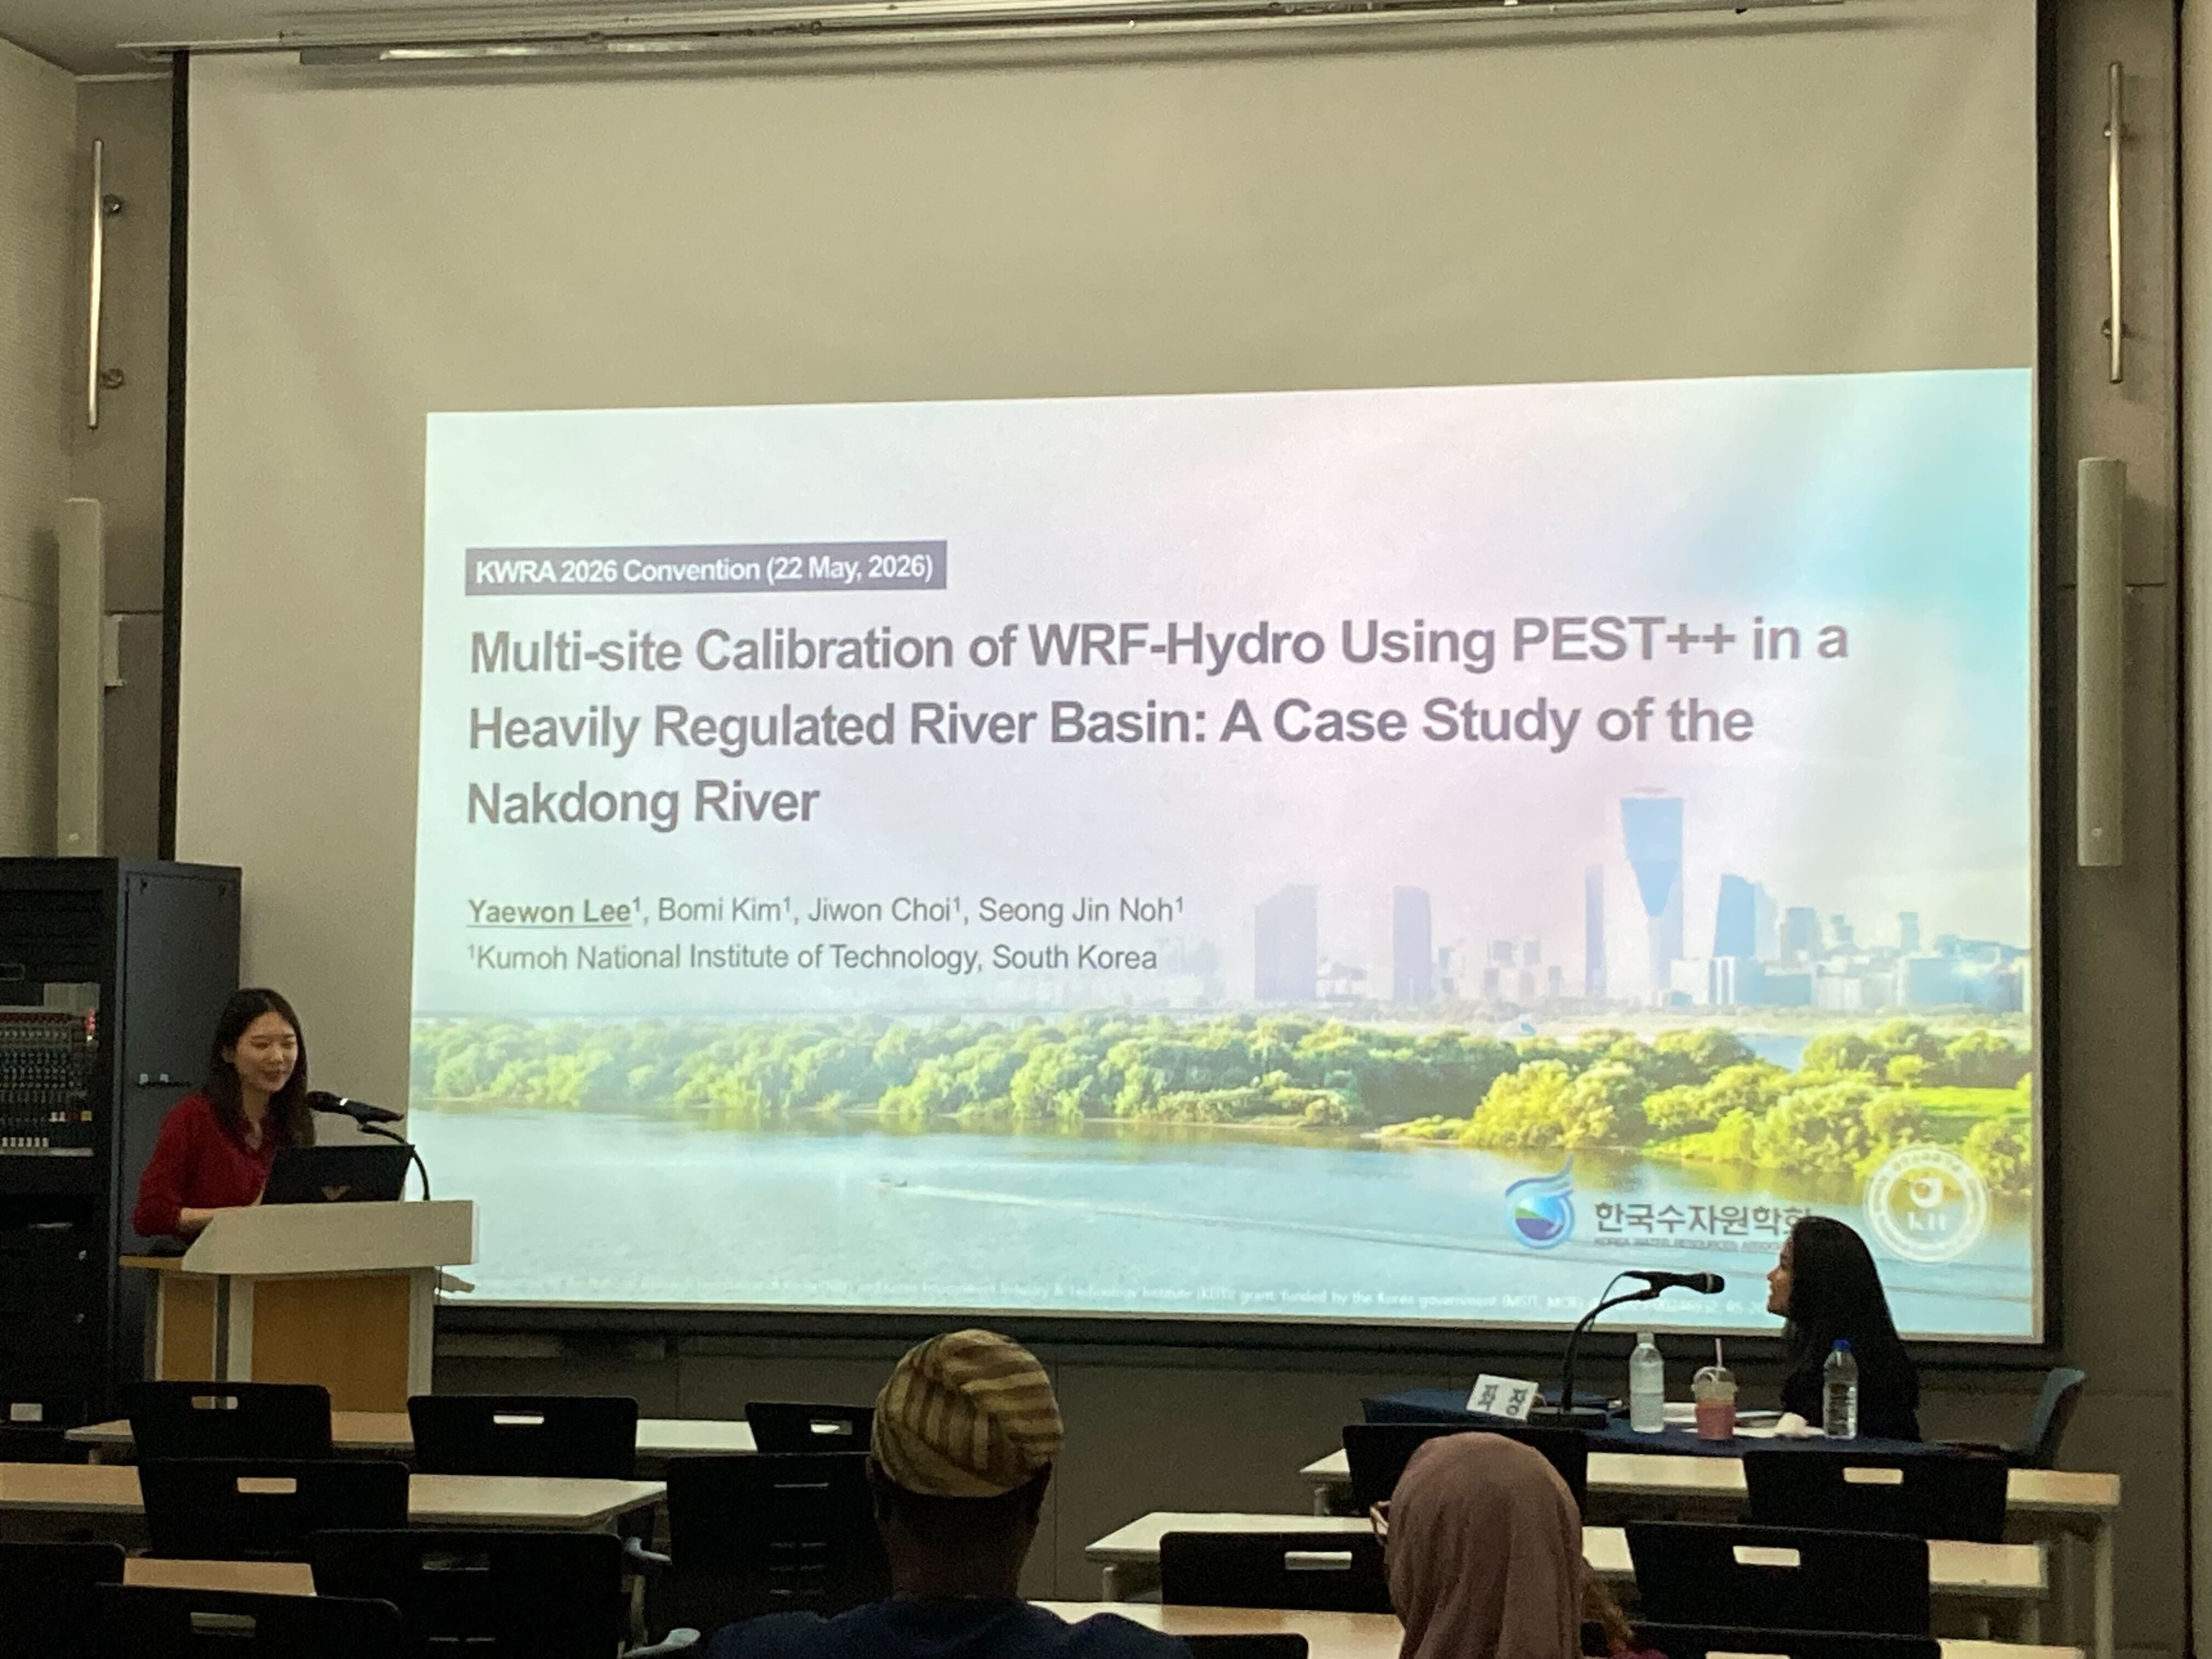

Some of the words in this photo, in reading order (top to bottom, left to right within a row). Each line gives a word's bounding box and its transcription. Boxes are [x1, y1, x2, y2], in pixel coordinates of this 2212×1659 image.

[476, 560, 557, 584] KWRA
[560, 559, 618, 583] 2026
[623, 557, 760, 582] Convention
[766, 556, 803, 586] (22
[809, 555, 862, 584] May,
[868, 554, 933, 583] 2026)
[471, 629, 682, 674] Multi-site
[696, 625, 953, 671] Calibration
[969, 623, 1019, 668] of
[1028, 620, 1325, 677] WRF-Hydro
[1342, 618, 1495, 675] Using
[1514, 616, 1736, 662] PEST++
[1753, 615, 1801, 661] in
[1818, 625, 1849, 659] a
[470, 705, 641, 759] Heavily
[654, 702, 895, 758] Regulated
[911, 701, 1038, 744] River
[1051, 699, 1206, 743] Basin:
[1219, 698, 1262, 742] A
[1273, 698, 1407, 743] Case
[1422, 696, 1582, 754] Study
[1596, 696, 1655, 742] of
[1666, 697, 1754, 743] the
[468, 780, 679, 833] Nakdong
[695, 779, 821, 822] River
[468, 899, 574, 923] Yaewon
[658, 897, 723, 922] Bomi
[808, 897, 882, 922] Jiwon
[979, 896, 1064, 928] Seong
[1072, 897, 1109, 922] Jin
[577, 943, 681, 969] National
[690, 943, 789, 968] Institute
[797, 943, 824, 968] of
[829, 944, 983, 975] Technology,
[992, 944, 1069, 969] South
[1078, 944, 1158, 970] Korea
